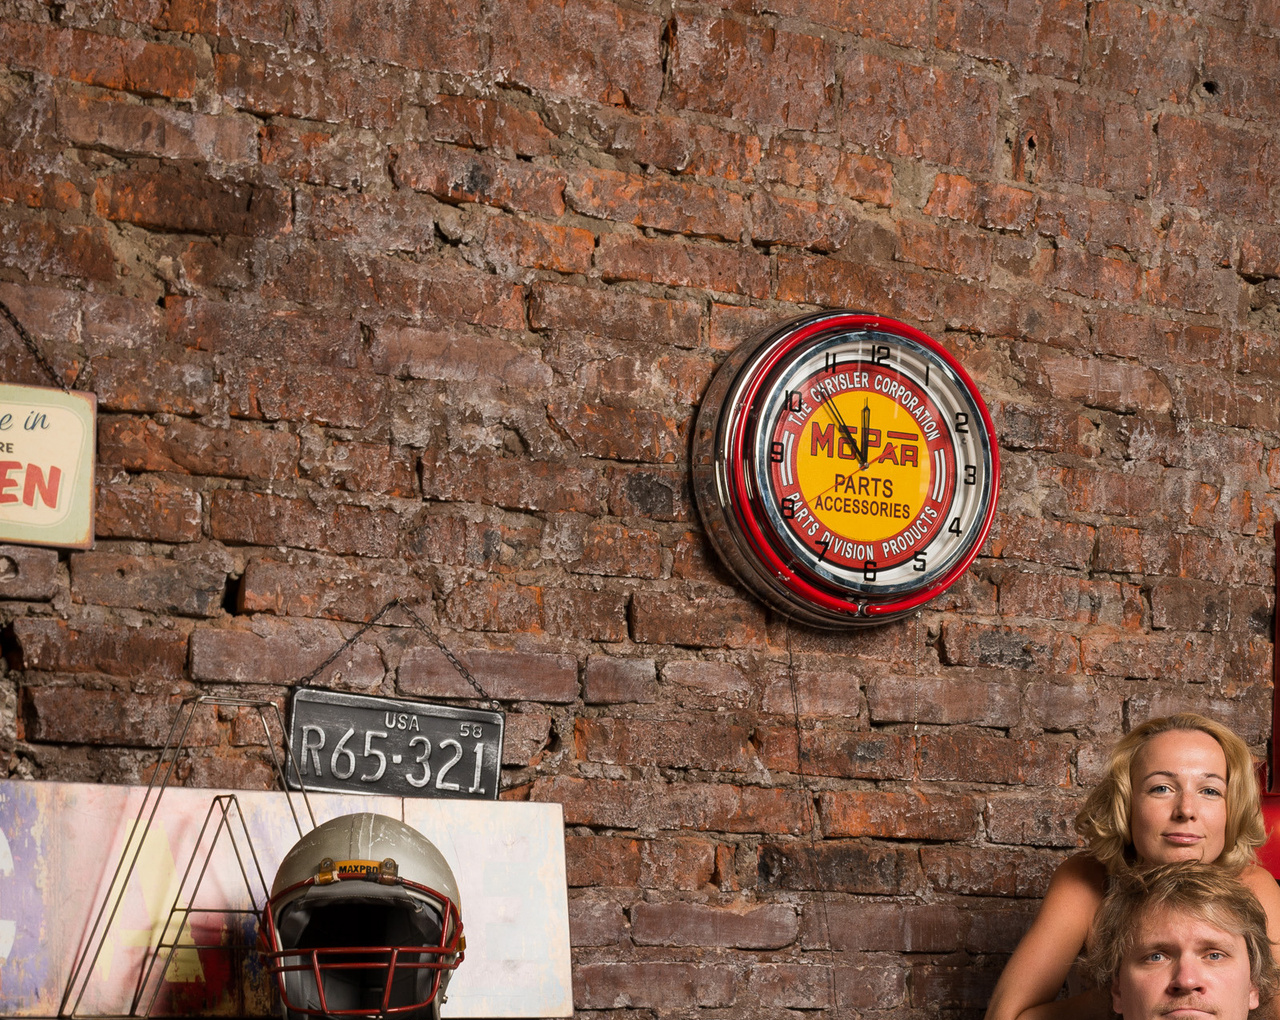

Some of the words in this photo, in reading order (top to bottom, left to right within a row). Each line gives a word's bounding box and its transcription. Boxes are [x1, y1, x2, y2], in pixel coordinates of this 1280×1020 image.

[870, 344, 891, 367] 12
[784, 389, 803, 413] 10
[788, 399, 813, 427] THE
[874, 374, 941, 442] CORPORATION
[24, 410, 50, 431] in
[955, 411, 969, 434] 2
[771, 441, 785, 463] 9
[810, 421, 919, 468] MOPAR
[834, 473, 894, 499] PARTS
[964, 464, 977, 486] 3
[781, 497, 796, 520] 8
[814, 495, 911, 520] ACCESSORIES
[786, 492, 820, 537] PARTS
[820, 530, 874, 561] DIVISION
[881, 506, 938, 558] PRODUCTS
[948, 517, 963, 538] 4
[815, 539, 830, 563] 7
[913, 550, 928, 573] 5
[863, 560, 878, 582] 6
[384, 712, 420, 732] USA
[459, 723, 483, 739] 58
